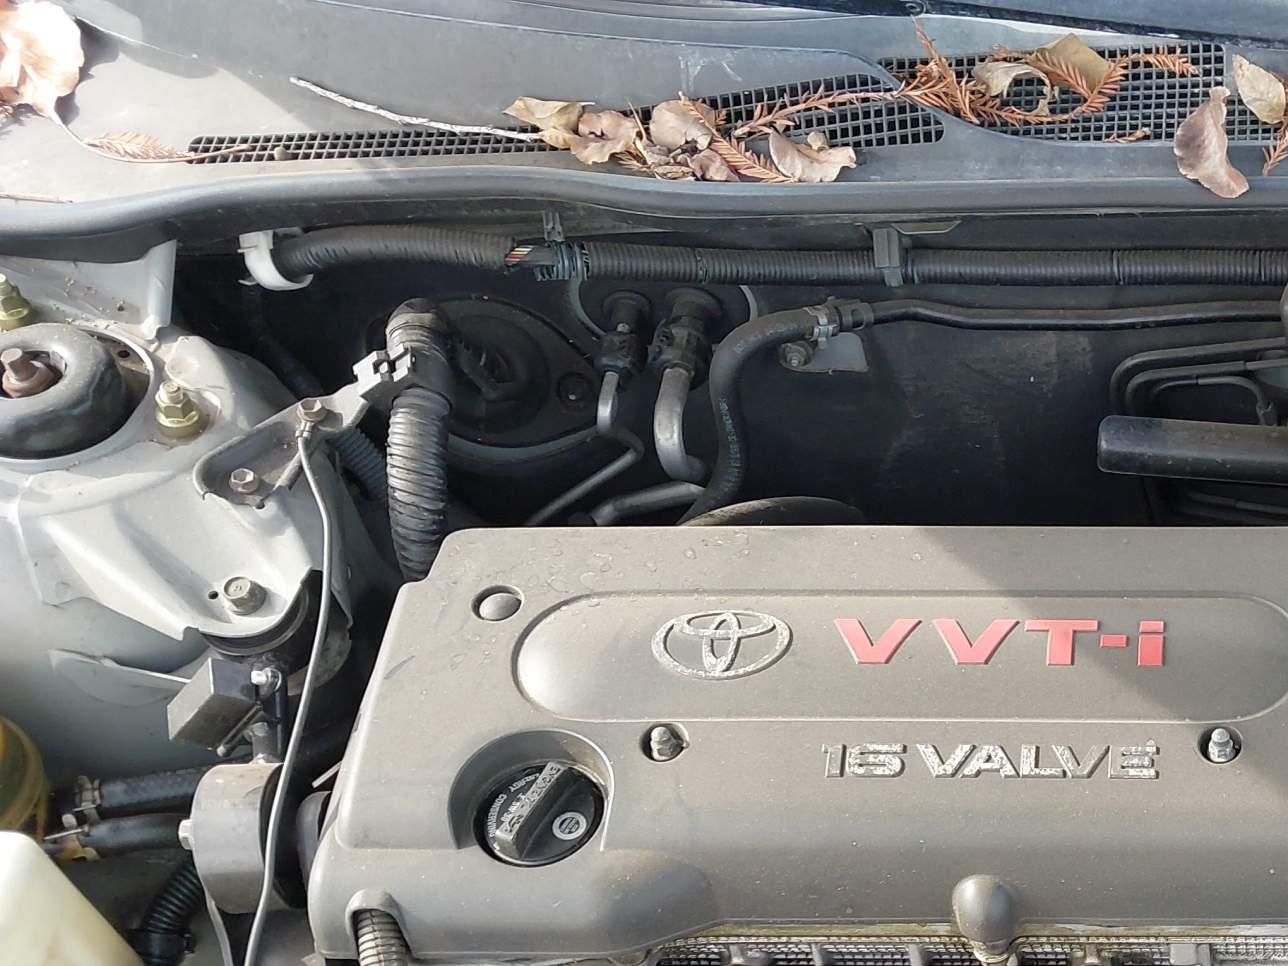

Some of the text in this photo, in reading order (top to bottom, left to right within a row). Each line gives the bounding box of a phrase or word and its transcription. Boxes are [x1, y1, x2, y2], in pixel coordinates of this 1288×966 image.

[835, 618, 1164, 665] VVT-i
[822, 743, 1160, 779] 16 VALVE
